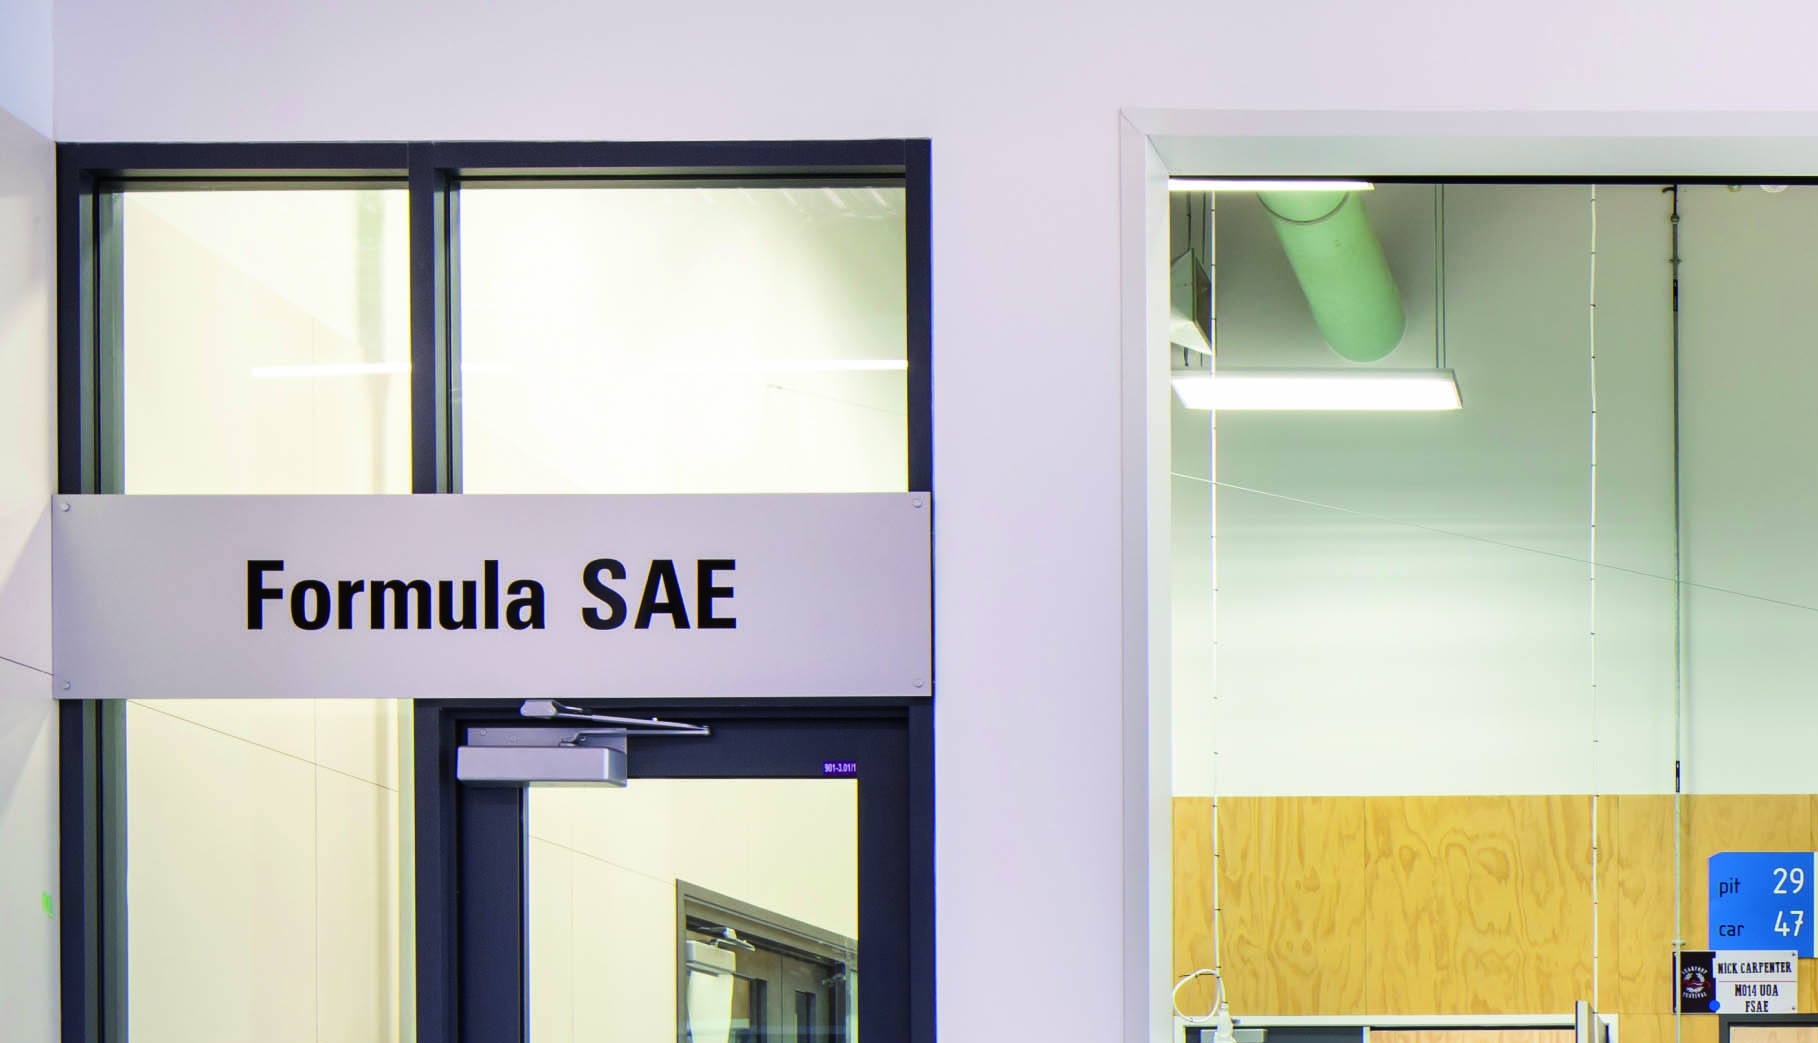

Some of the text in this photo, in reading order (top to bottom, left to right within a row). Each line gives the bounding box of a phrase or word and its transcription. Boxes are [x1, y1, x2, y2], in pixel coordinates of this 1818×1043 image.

[246, 558, 737, 631] Formula SAE
[1718, 867, 1805, 898] pit 29
[1718, 910, 1805, 937] car 47
[1740, 961, 1793, 974] CARPENTER
[1759, 983, 1779, 997] UOA
[1744, 1000, 1769, 1013] FSAE
